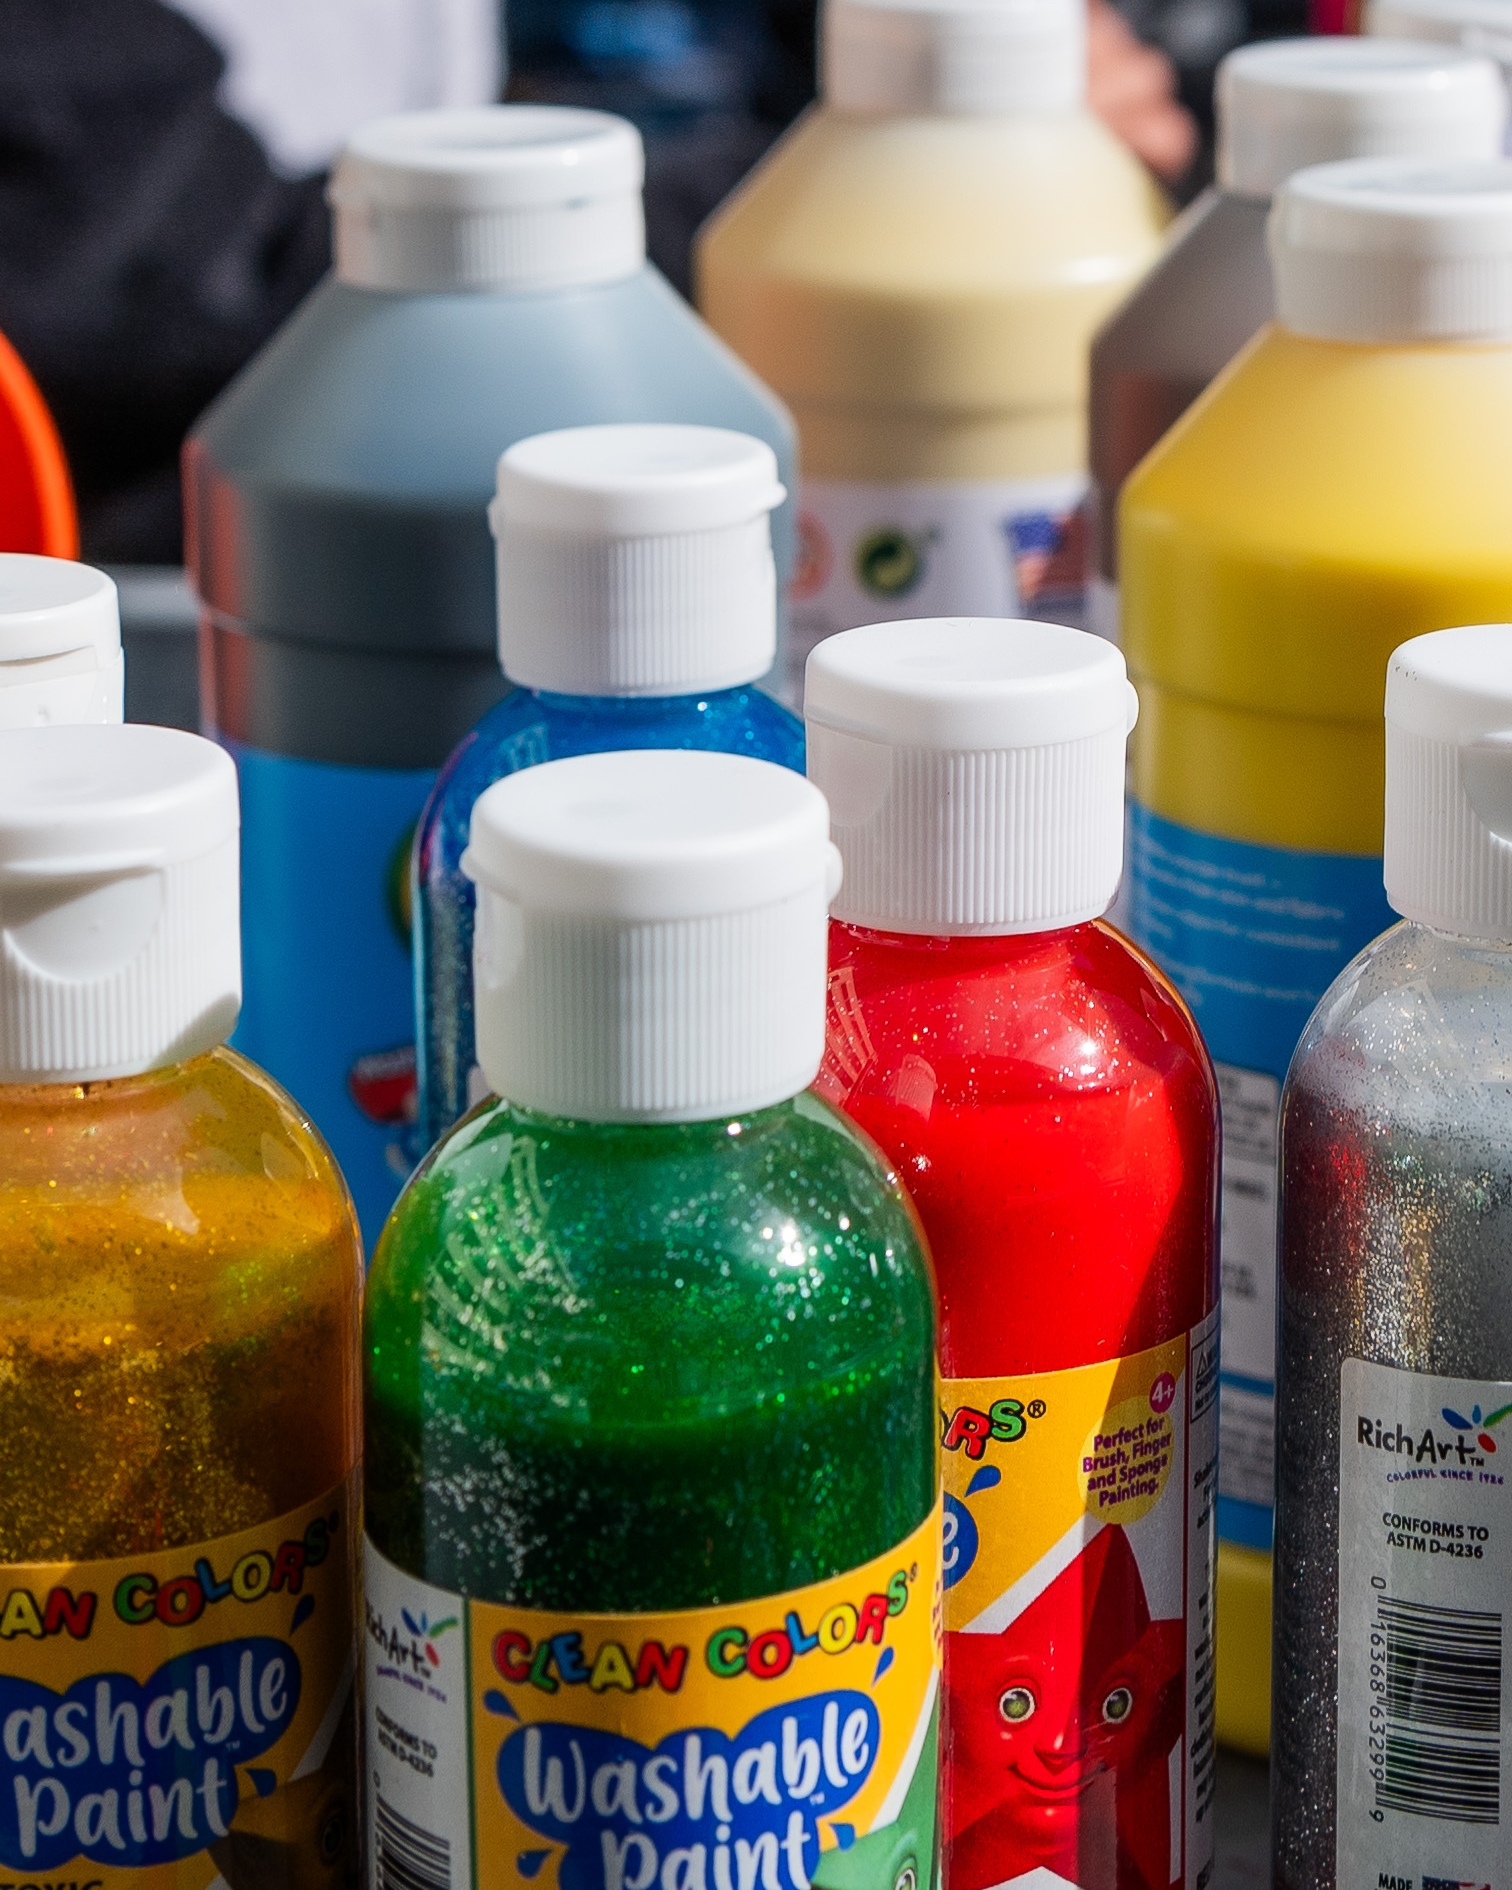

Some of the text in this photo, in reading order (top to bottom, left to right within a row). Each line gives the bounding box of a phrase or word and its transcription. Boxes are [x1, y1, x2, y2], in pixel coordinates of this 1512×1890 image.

[1151, 1381, 1174, 1403] 4+
[1082, 1432, 1172, 1473] Brush, Finger
[1093, 1417, 1165, 1452] Perfect for
[1357, 1414, 1476, 1465] RichArt
[1087, 1453, 1168, 1491] and Sponge
[1386, 1468, 1437, 1483] COLORFUL
[1382, 1512, 1490, 1541] CONFORMS TO
[1386, 1531, 1484, 1560] ASTM D-4236
[113, 1517, 328, 1625] COLORS
[491, 1628, 688, 1694] CLEAN
[705, 1569, 908, 1680] COLORS
[523, 1700, 870, 1824] Washable
